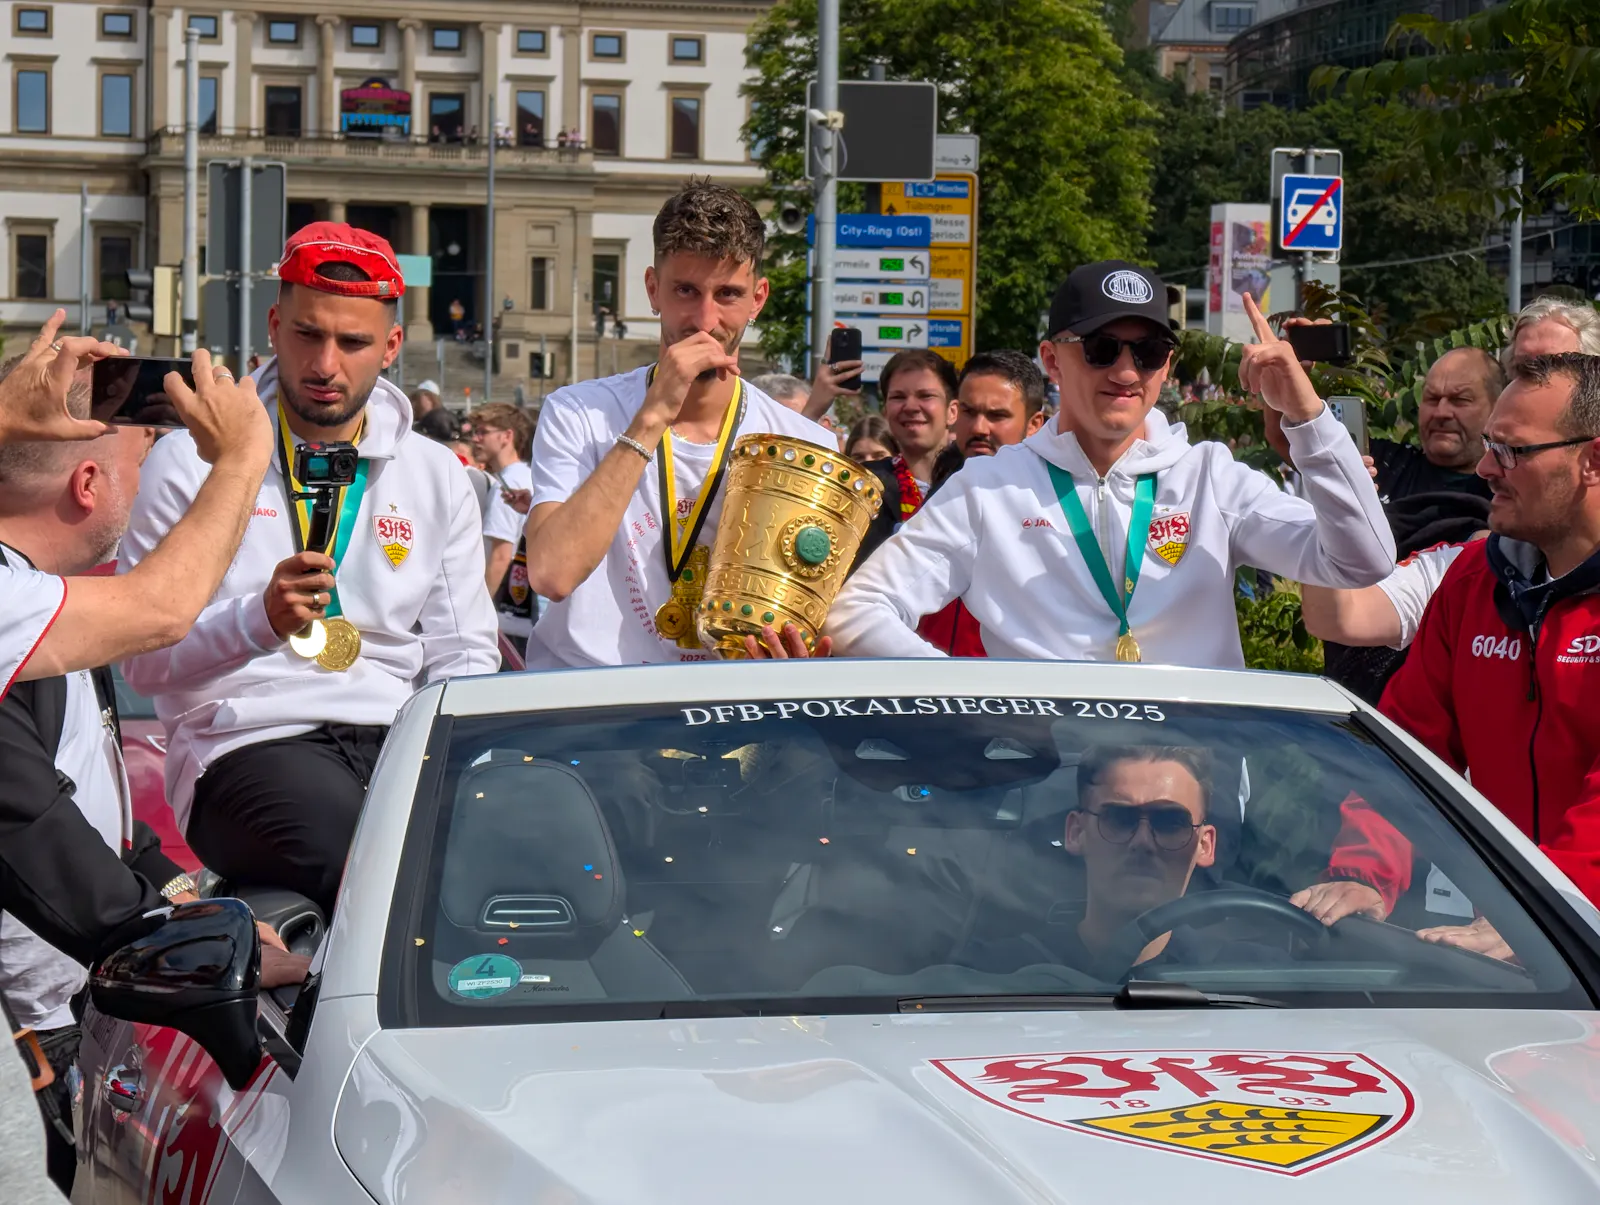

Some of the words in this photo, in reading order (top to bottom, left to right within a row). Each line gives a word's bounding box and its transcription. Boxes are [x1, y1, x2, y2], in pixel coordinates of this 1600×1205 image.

[905, 200, 953, 212] Tübingen
[935, 218, 965, 226] Messe
[840, 224, 893, 239] City-Ring
[896, 225, 923, 237] (Ost)
[1112, 276, 1147, 297] BUXTON
[1471, 634, 1522, 661] 6040
[679, 654, 706, 662] 2025
[1556, 655, 1589, 664] SECURITY
[683, 697, 1065, 726] DFB-POKALSIEGER
[1072, 701, 1166, 722] 2025
[475, 957, 496, 977] 4
[1100, 1098, 1152, 1110] 18
[1278, 1095, 1332, 1107] 93
